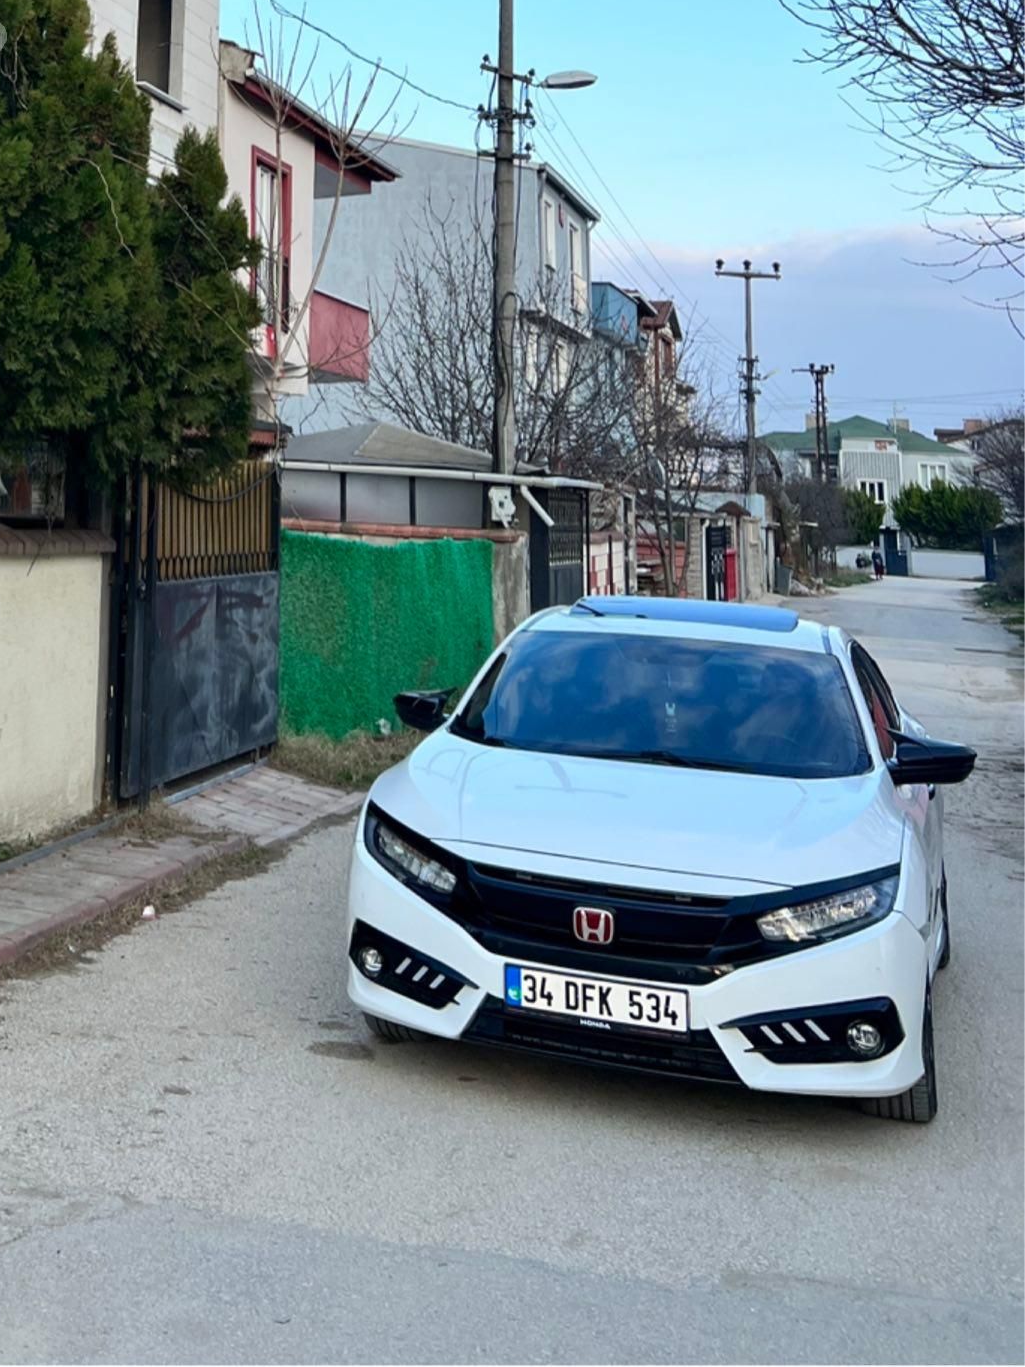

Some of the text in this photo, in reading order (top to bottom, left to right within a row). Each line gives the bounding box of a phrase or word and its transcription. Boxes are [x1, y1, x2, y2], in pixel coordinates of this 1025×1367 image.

[523, 974, 679, 1027] 34 DFK 534
[579, 1018, 611, 1030] HONDA
